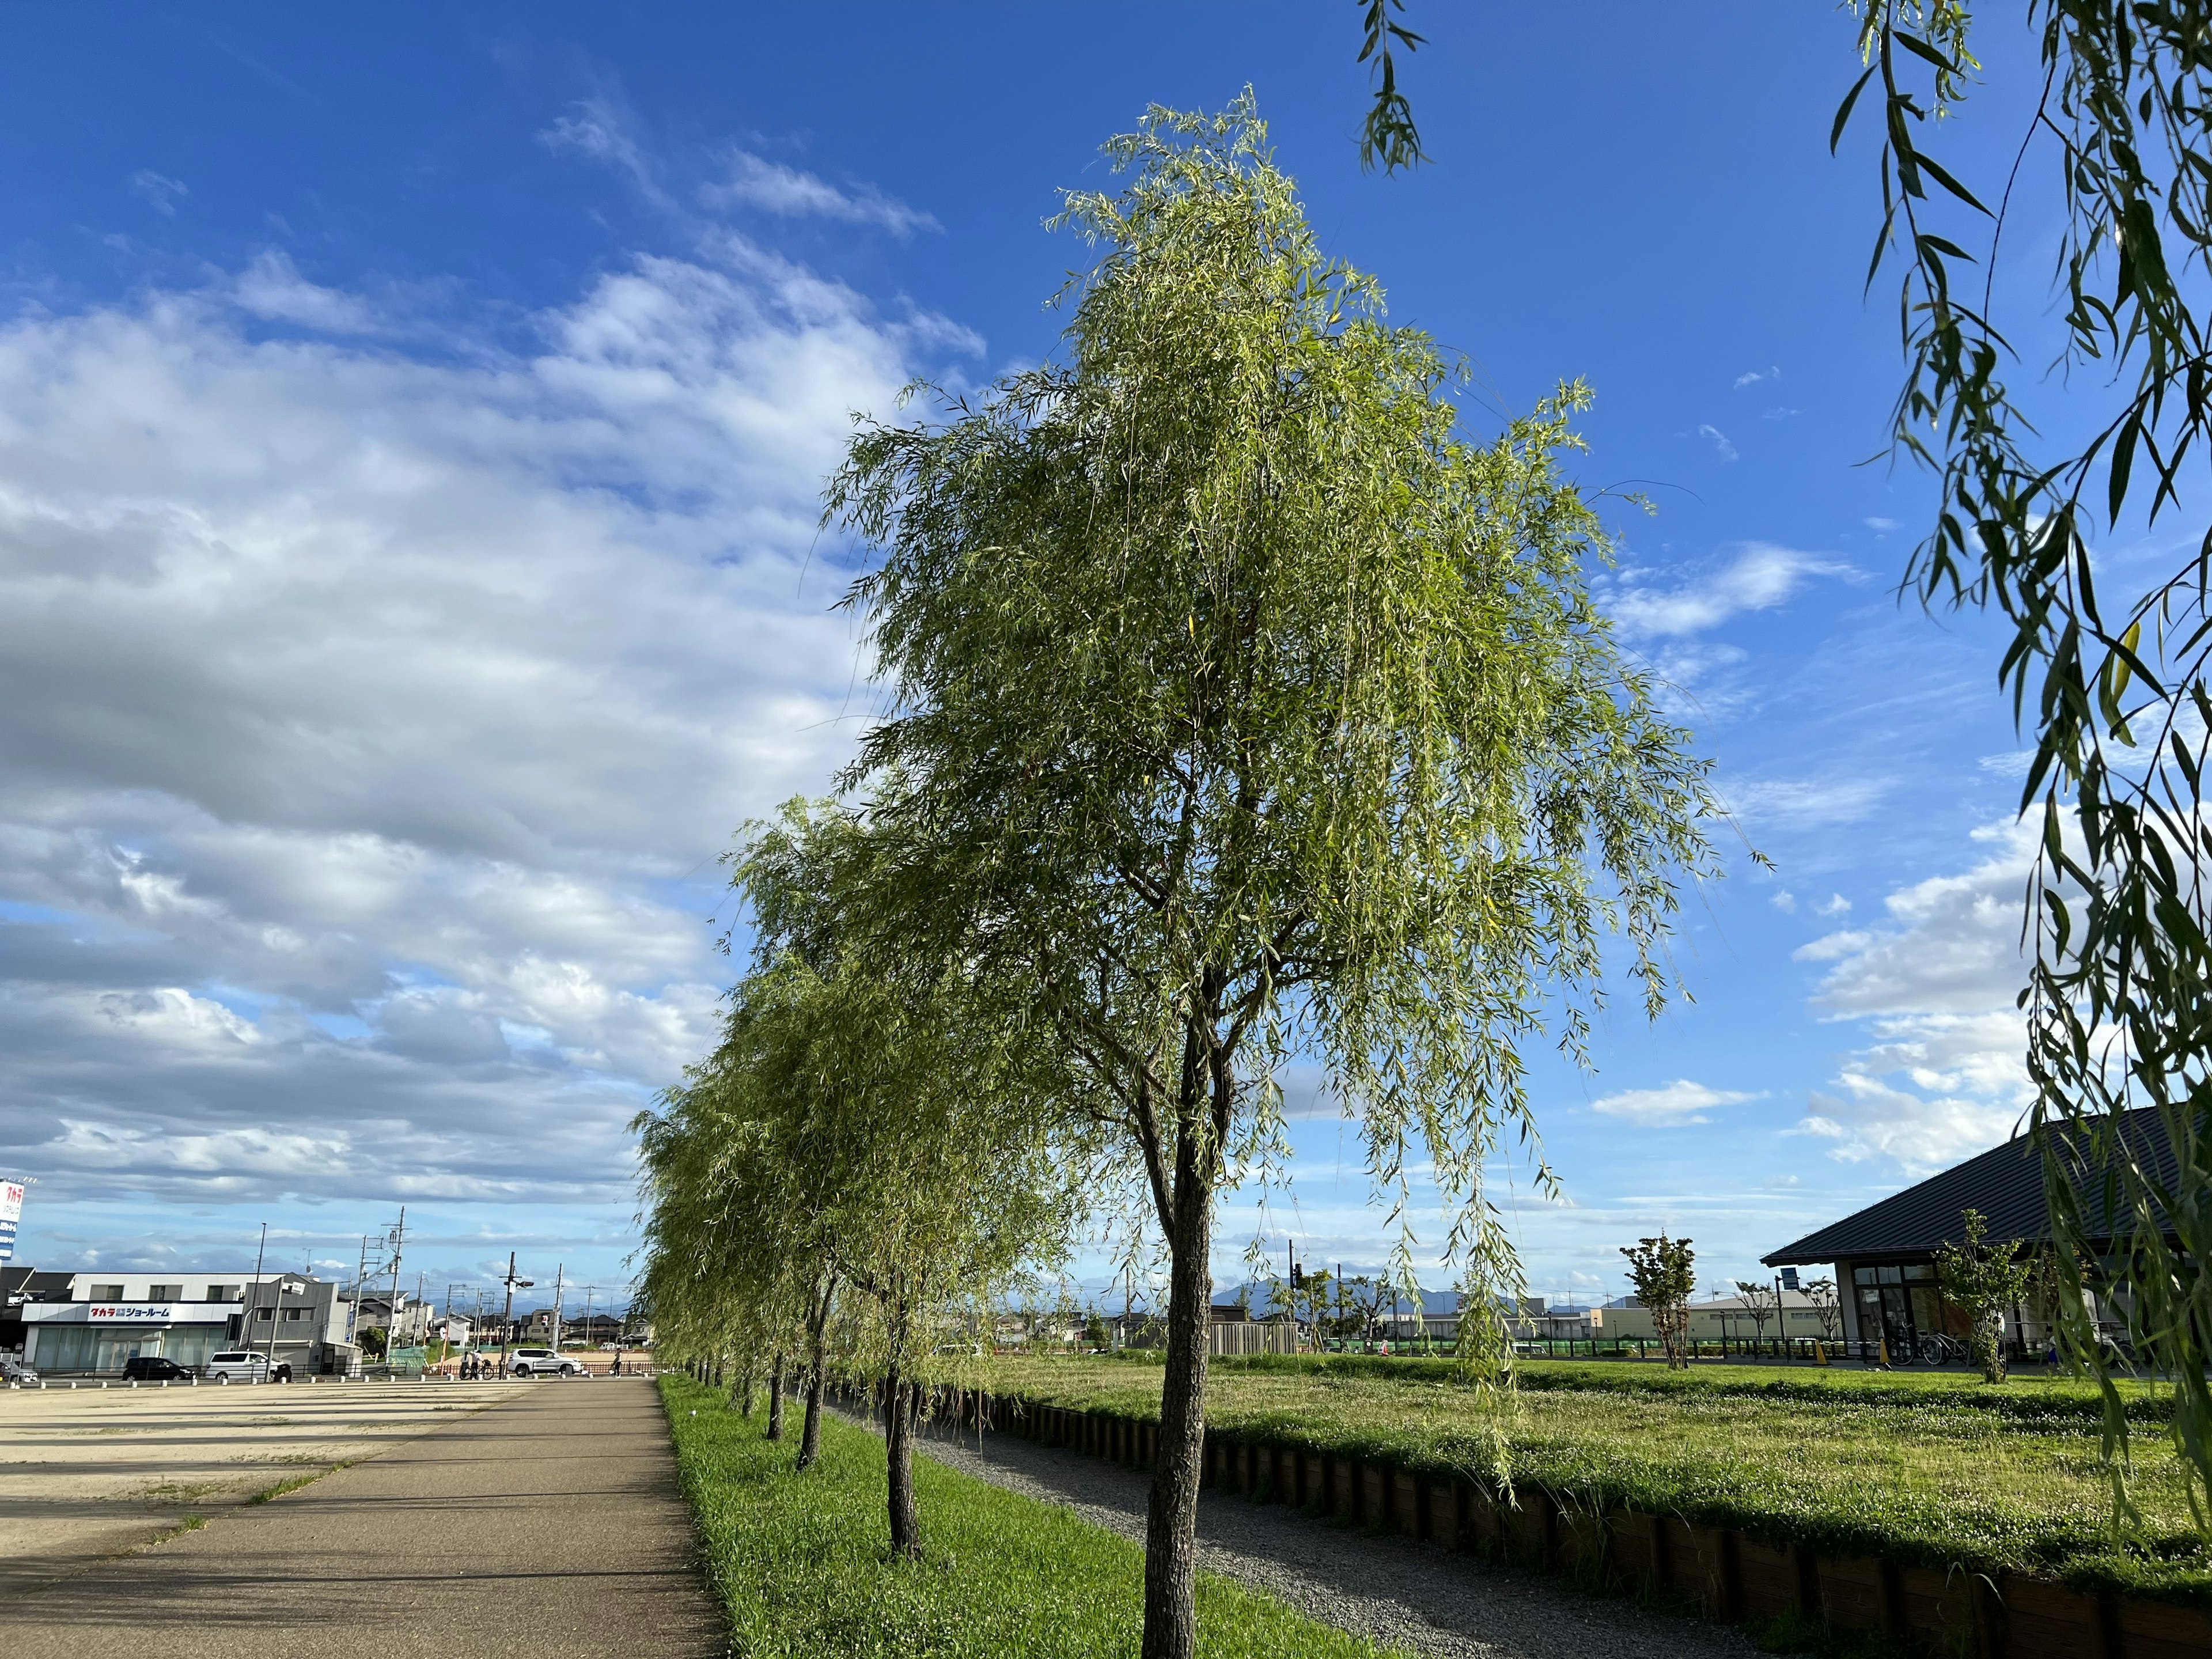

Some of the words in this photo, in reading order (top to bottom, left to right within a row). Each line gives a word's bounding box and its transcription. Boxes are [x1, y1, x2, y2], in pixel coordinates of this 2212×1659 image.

[7, 1187, 22, 1203] タカラ
[90, 1308, 116, 1317] タカラ
[126, 1308, 169, 1317] ショールーム
